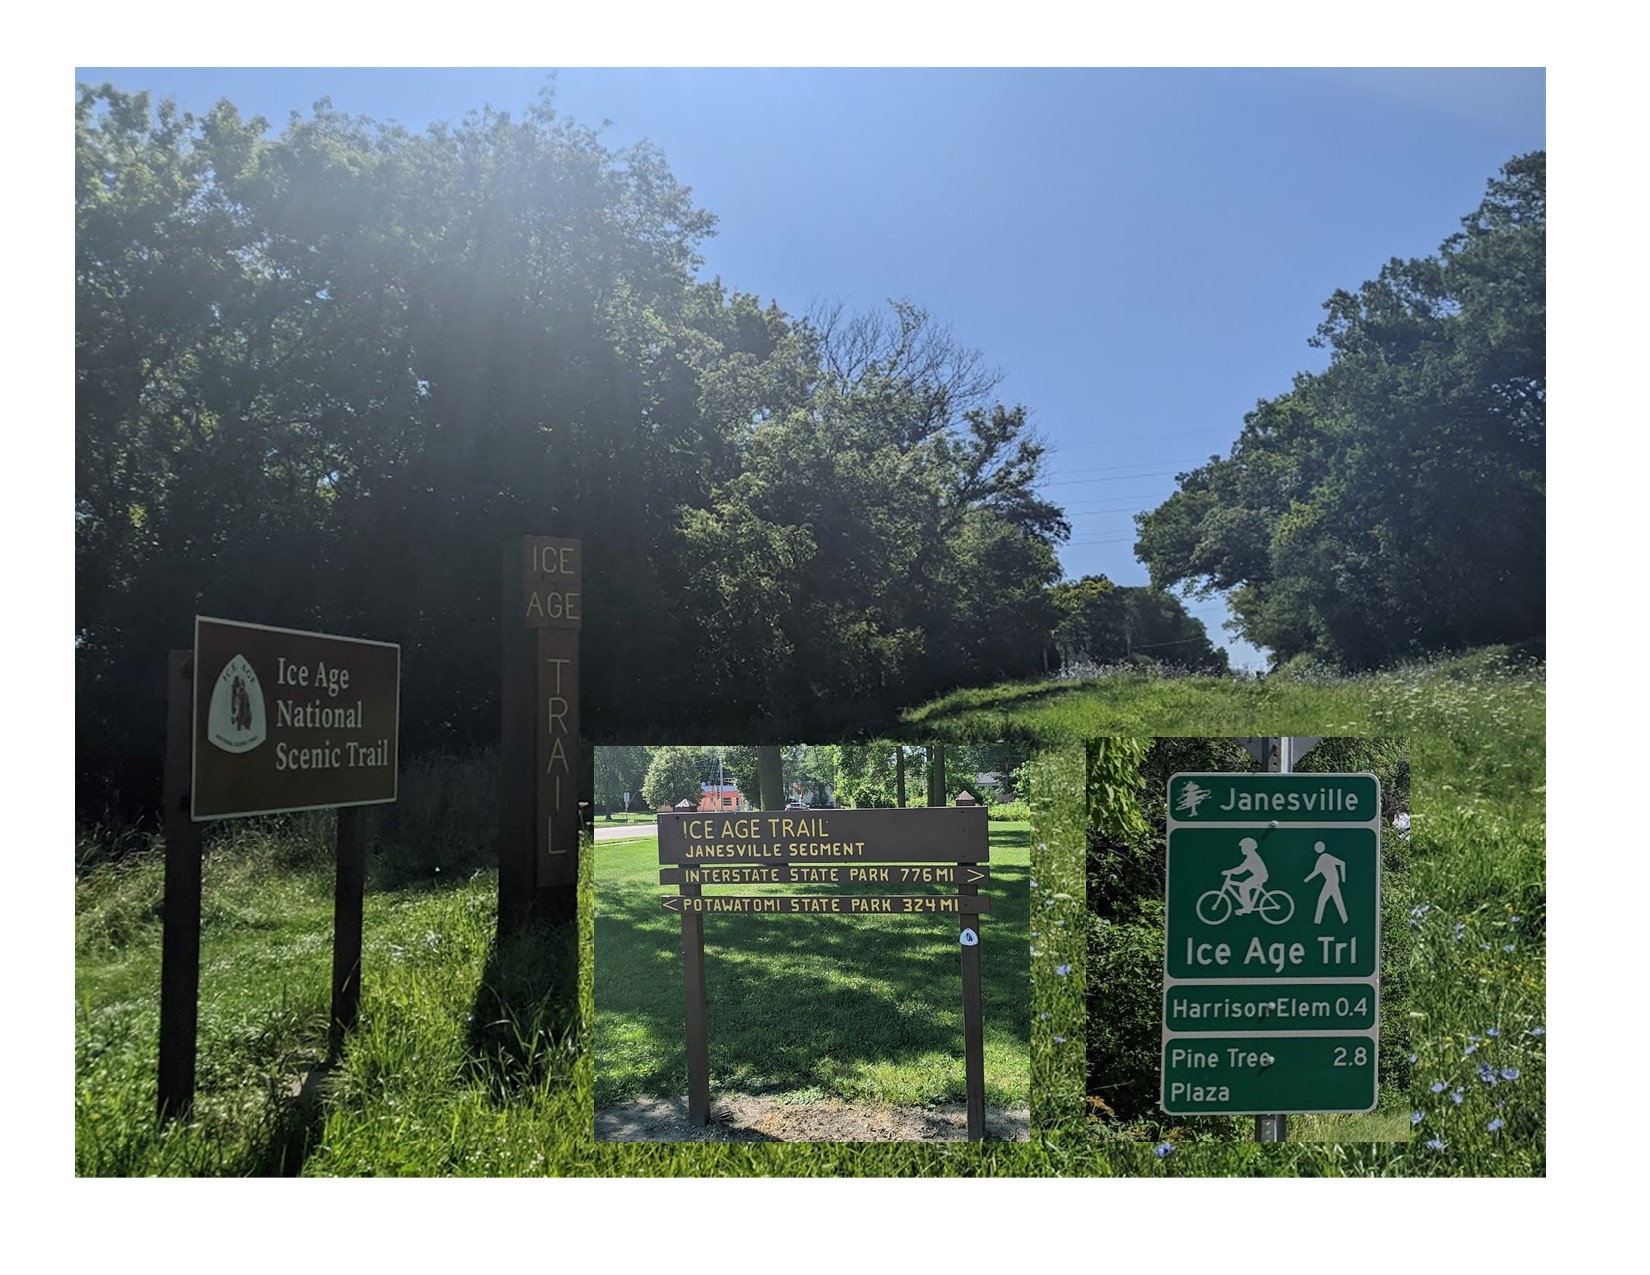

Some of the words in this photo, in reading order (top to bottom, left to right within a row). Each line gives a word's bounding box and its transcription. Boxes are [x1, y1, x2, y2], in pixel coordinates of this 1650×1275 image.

[532, 545, 575, 575] ICE
[526, 591, 581, 620] AGE
[277, 657, 309, 686] Ice
[314, 661, 350, 697] Age
[276, 699, 363, 729] National
[275, 740, 341, 771] Scenic
[346, 739, 389, 767] Trail
[547, 658, 570, 855] TRAIL
[1219, 787, 1360, 812] Janesville
[682, 819, 713, 840] ICE
[721, 818, 761, 839] AGE
[768, 818, 830, 838] TRAIL
[685, 843, 782, 858] JANESVILLE
[789, 842, 865, 857] SEGMENT
[685, 868, 780, 883] INTERSTATE
[790, 868, 839, 882] STATE
[849, 868, 890, 882] PARK
[683, 898, 780, 912] POTAWATOMI
[790, 898, 839, 912] STATE
[851, 898, 890, 912] PARK
[1186, 937, 1232, 965] Ice
[1243, 937, 1306, 973] Age
[1317, 937, 1358, 964] Trl
[1173, 999, 1271, 1018] Harrison
[1277, 998, 1330, 1018] Elem
[1335, 998, 1368, 1017] 0.4
[1171, 1049, 1219, 1069] Pine
[1227, 1048, 1273, 1068] Tree
[1333, 1047, 1368, 1067] 2.8
[1170, 1083, 1230, 1102] Plaza
